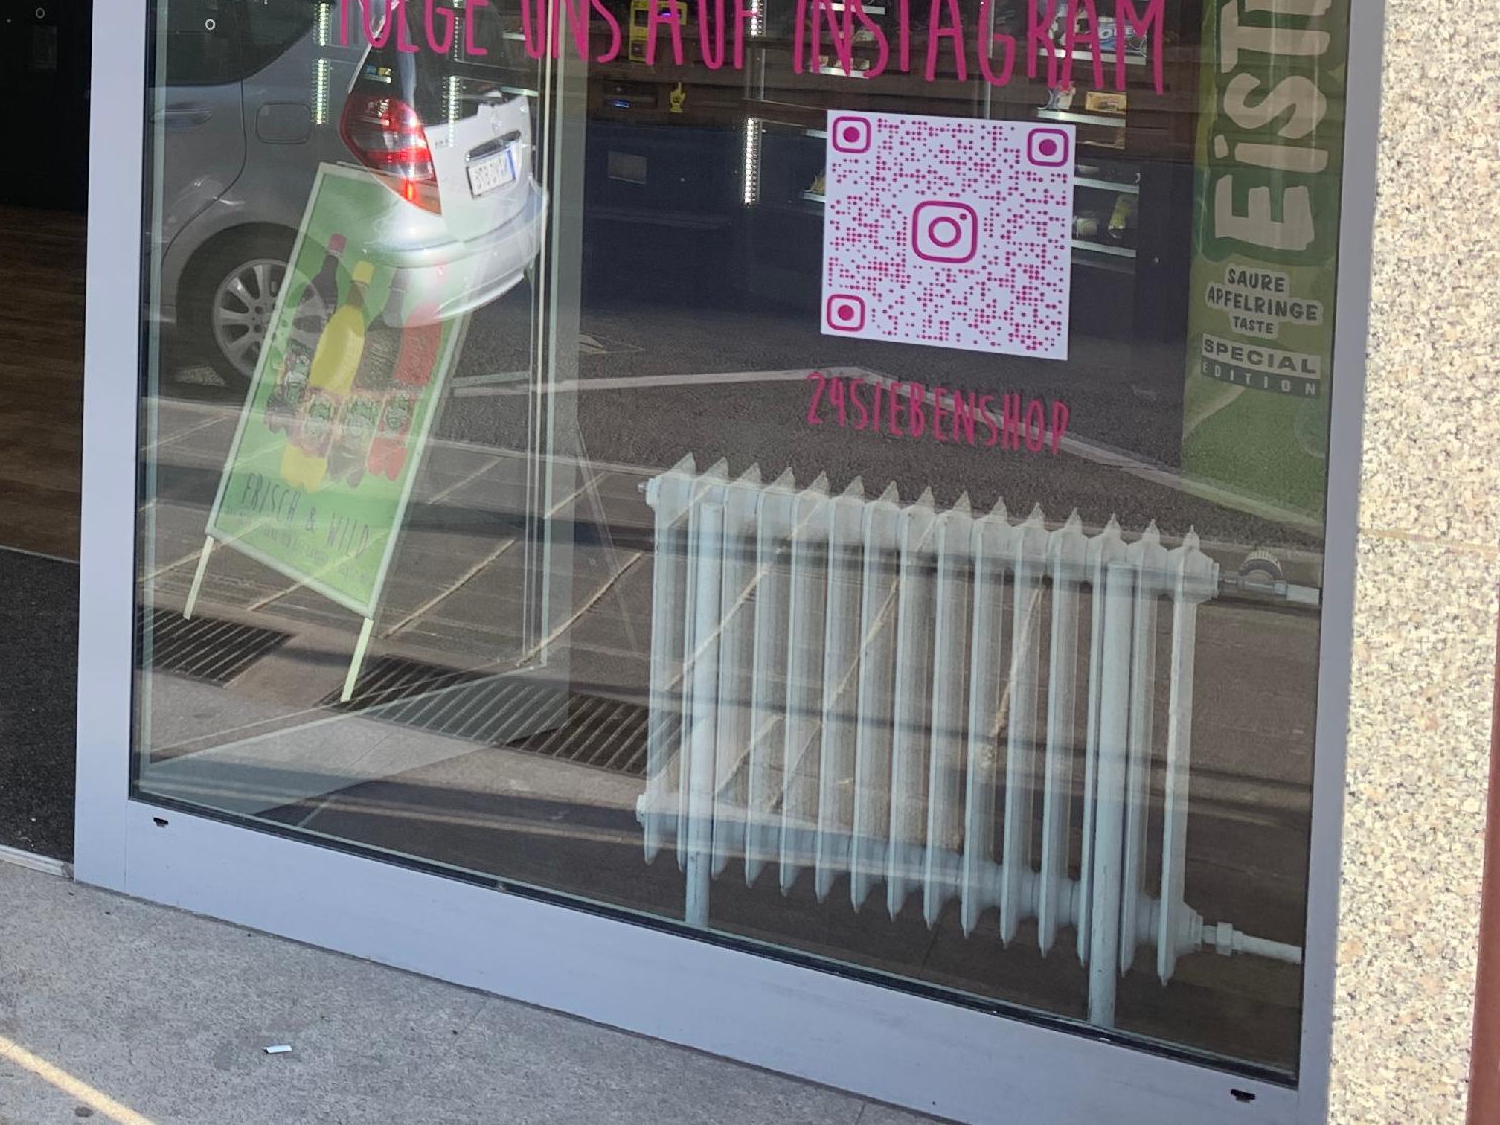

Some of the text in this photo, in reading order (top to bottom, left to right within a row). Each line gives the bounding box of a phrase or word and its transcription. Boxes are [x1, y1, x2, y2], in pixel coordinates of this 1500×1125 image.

[1227, 268, 1285, 293] SAURE
[1207, 285, 1319, 321] APFELRINGE
[1232, 315, 1275, 334] TASTE
[1204, 338, 1317, 375] SPECIAL
[1202, 362, 1317, 396] EDITION
[806, 370, 1070, 455] 24SIEBENSHOP
